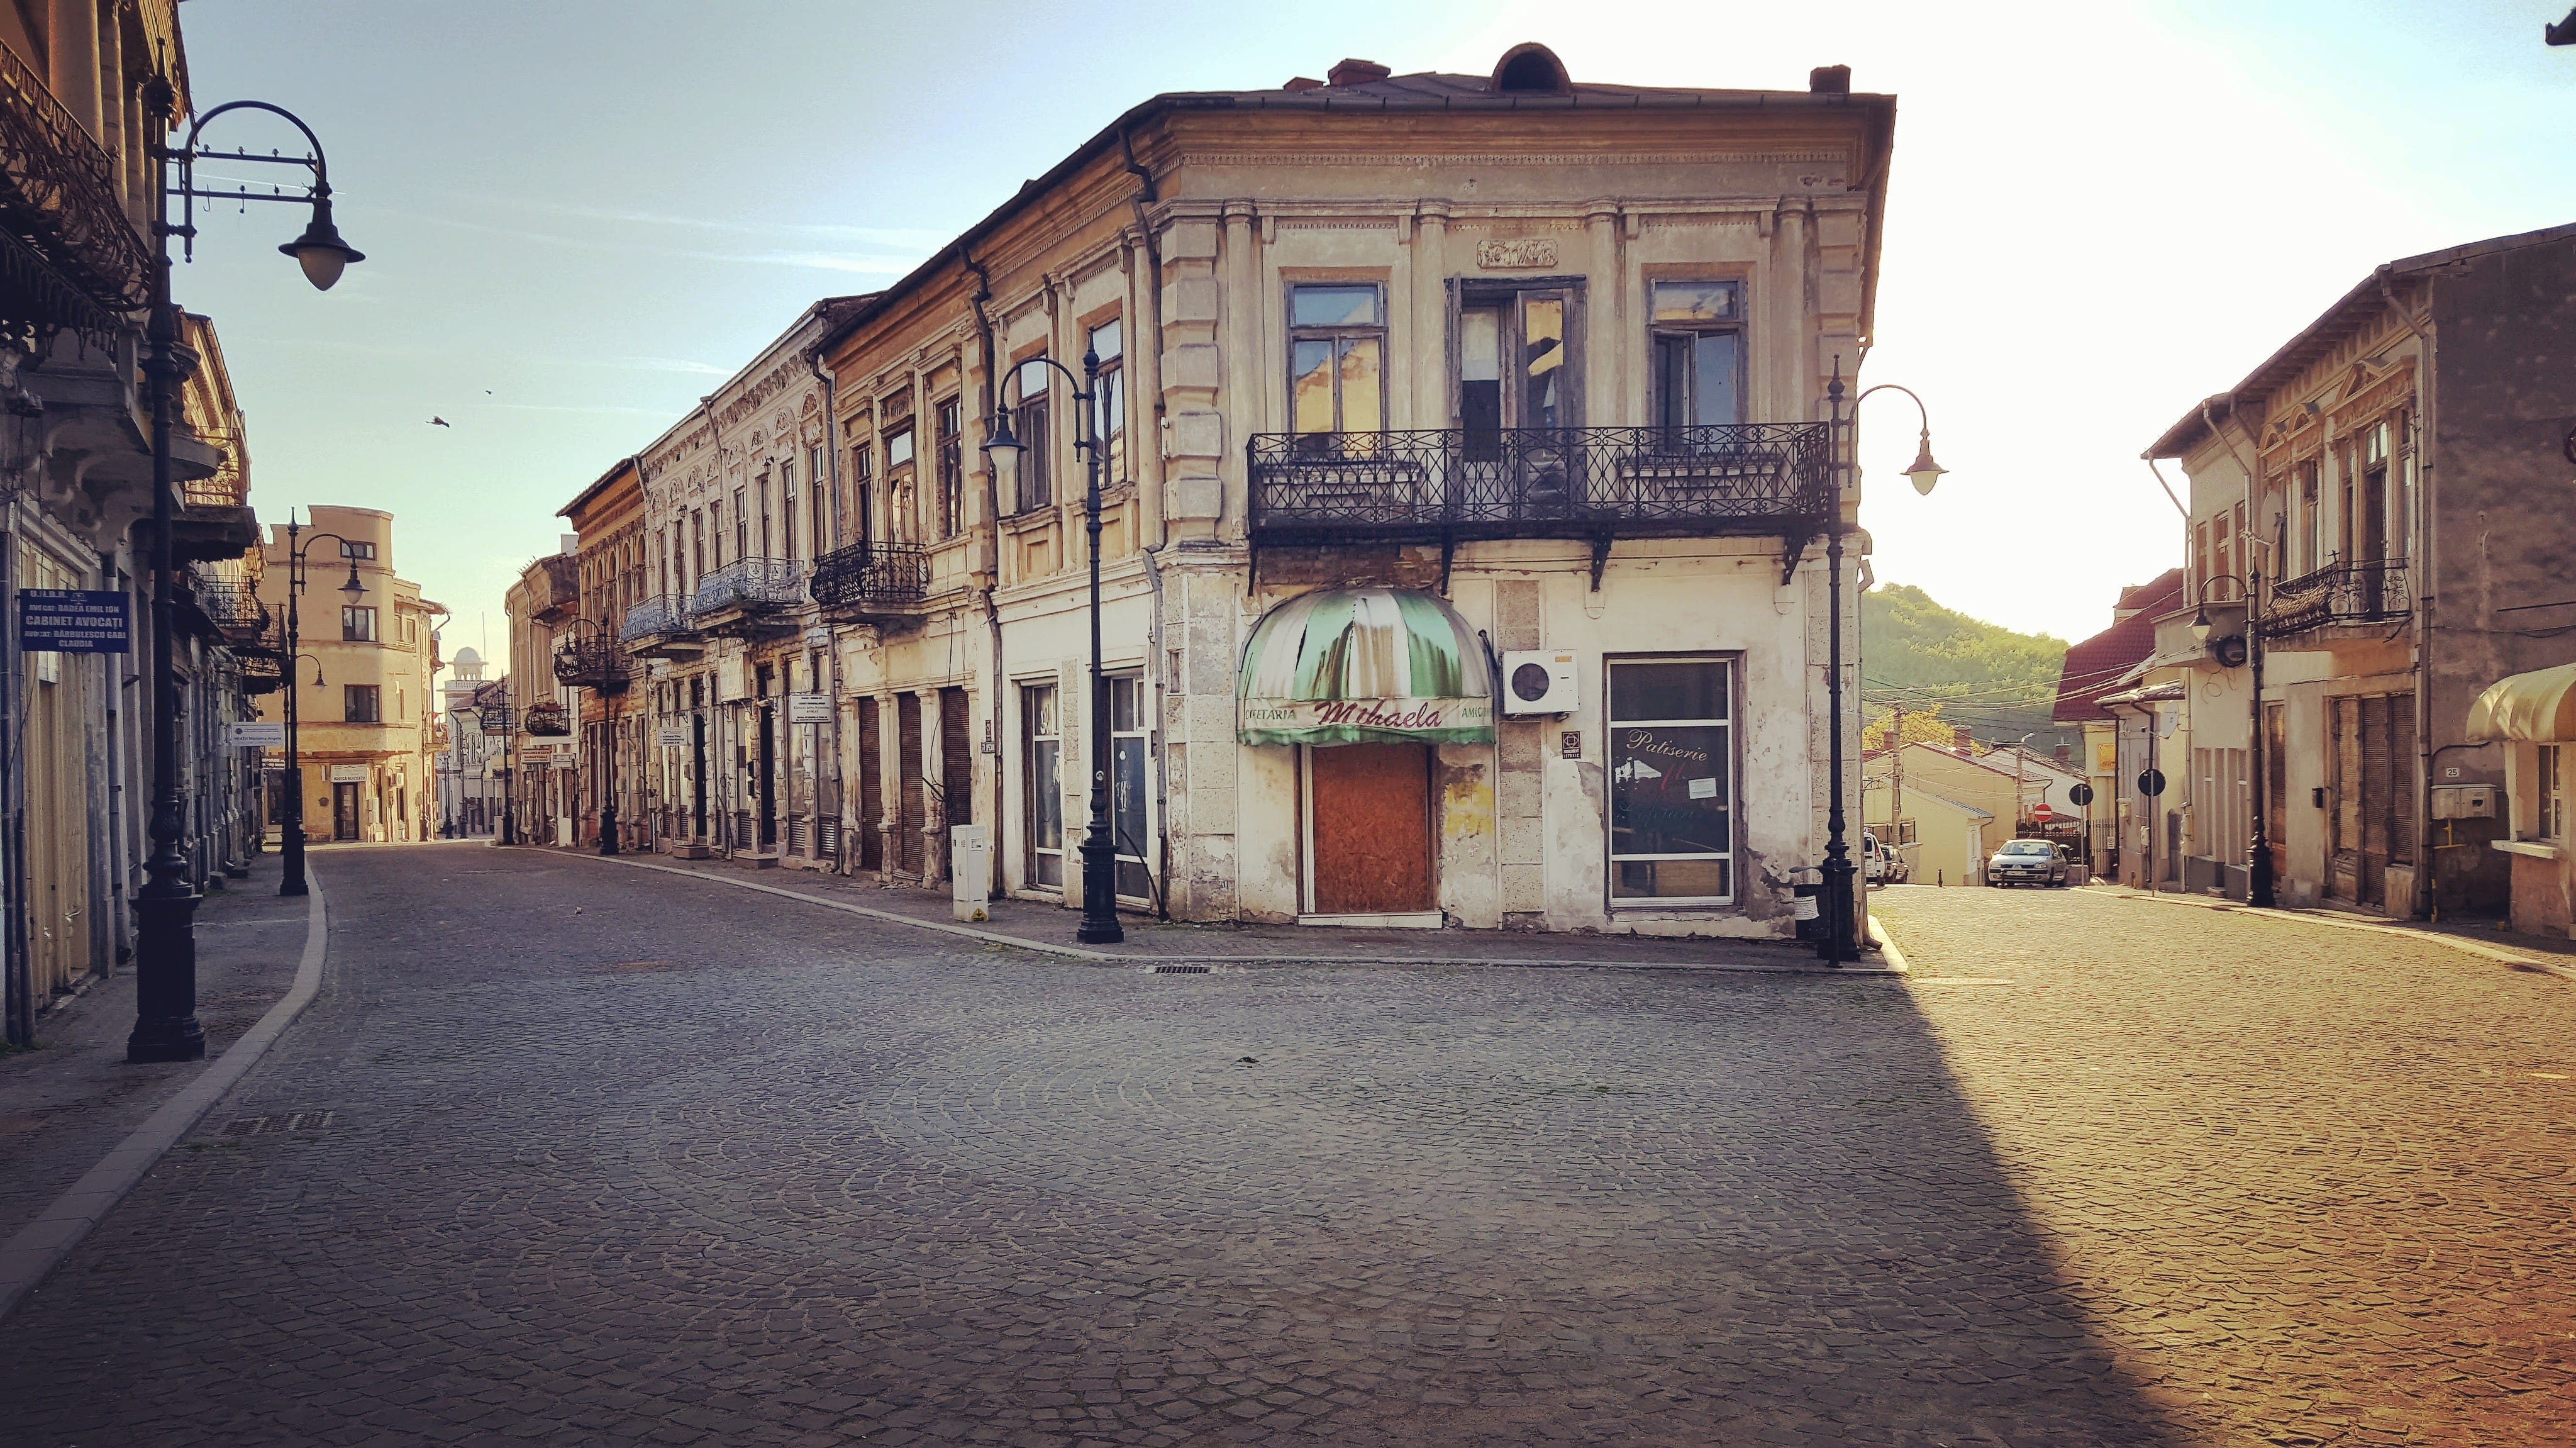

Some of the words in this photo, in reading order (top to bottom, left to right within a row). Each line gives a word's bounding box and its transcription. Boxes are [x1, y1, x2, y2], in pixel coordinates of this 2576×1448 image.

[26, 616, 74, 626] CABINET
[1314, 699, 1442, 728] Mihaela
[1626, 729, 1707, 761] Patiserie
